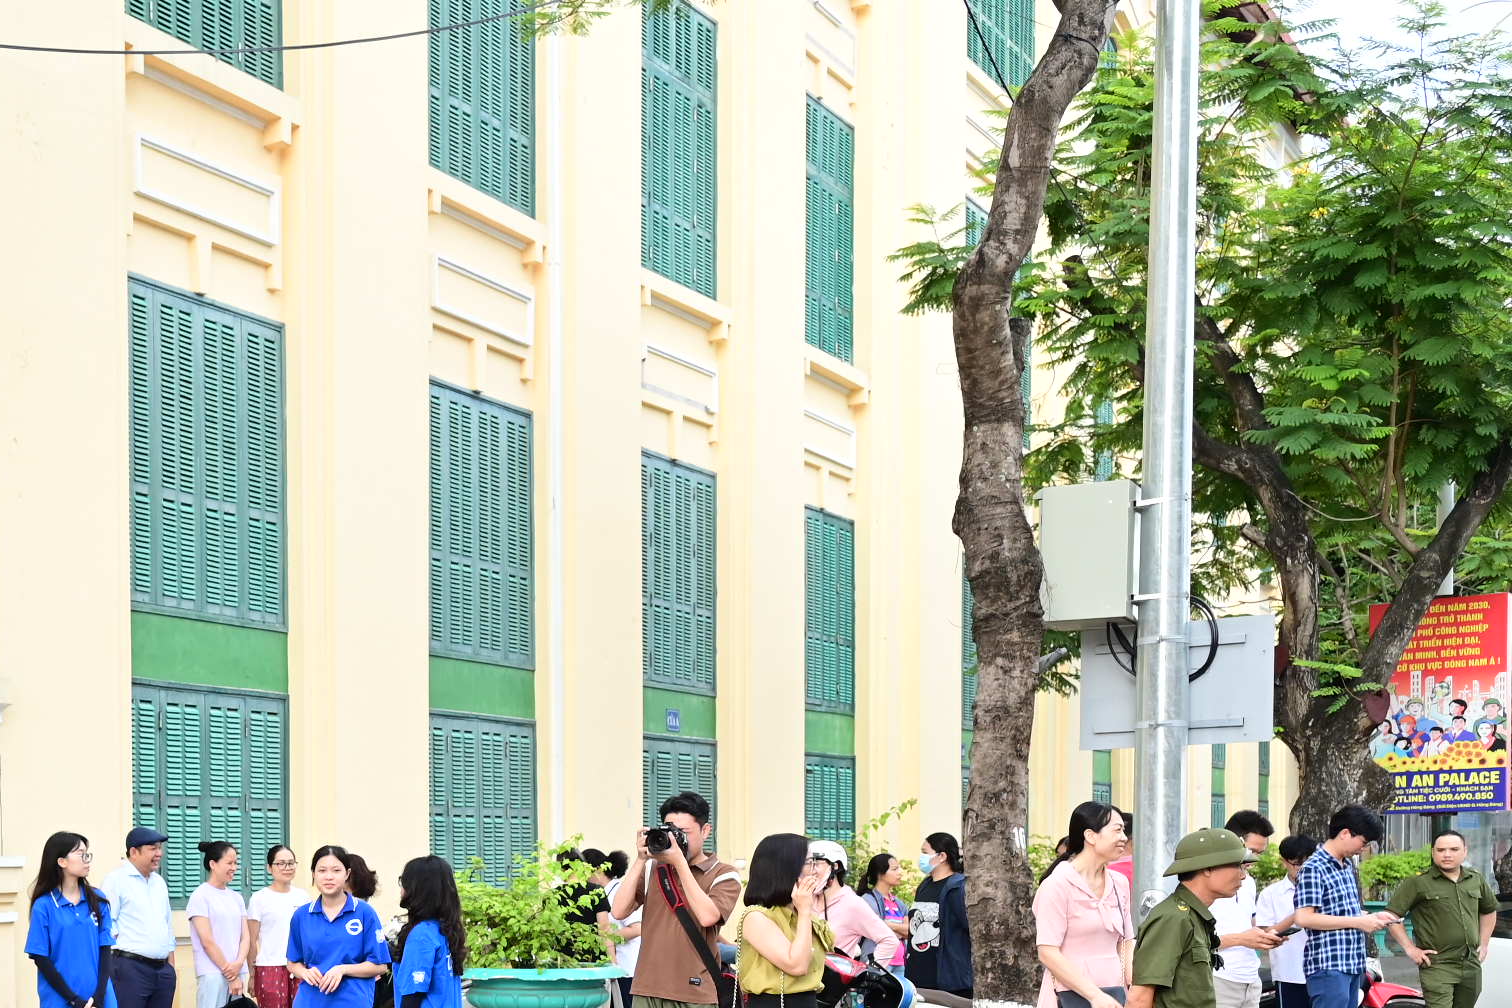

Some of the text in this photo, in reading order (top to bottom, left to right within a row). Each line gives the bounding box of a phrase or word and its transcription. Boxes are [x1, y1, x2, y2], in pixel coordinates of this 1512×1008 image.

[1457, 612, 1483, 622] THÀNH
[1435, 626, 1457, 635] CÔNG
[1459, 624, 1488, 634] NGHIỆP
[1409, 662, 1425, 671] KHU
[1468, 658, 1487, 667] NAM
[1411, 774, 1435, 787] AN
[1439, 770, 1500, 786] PALACE
